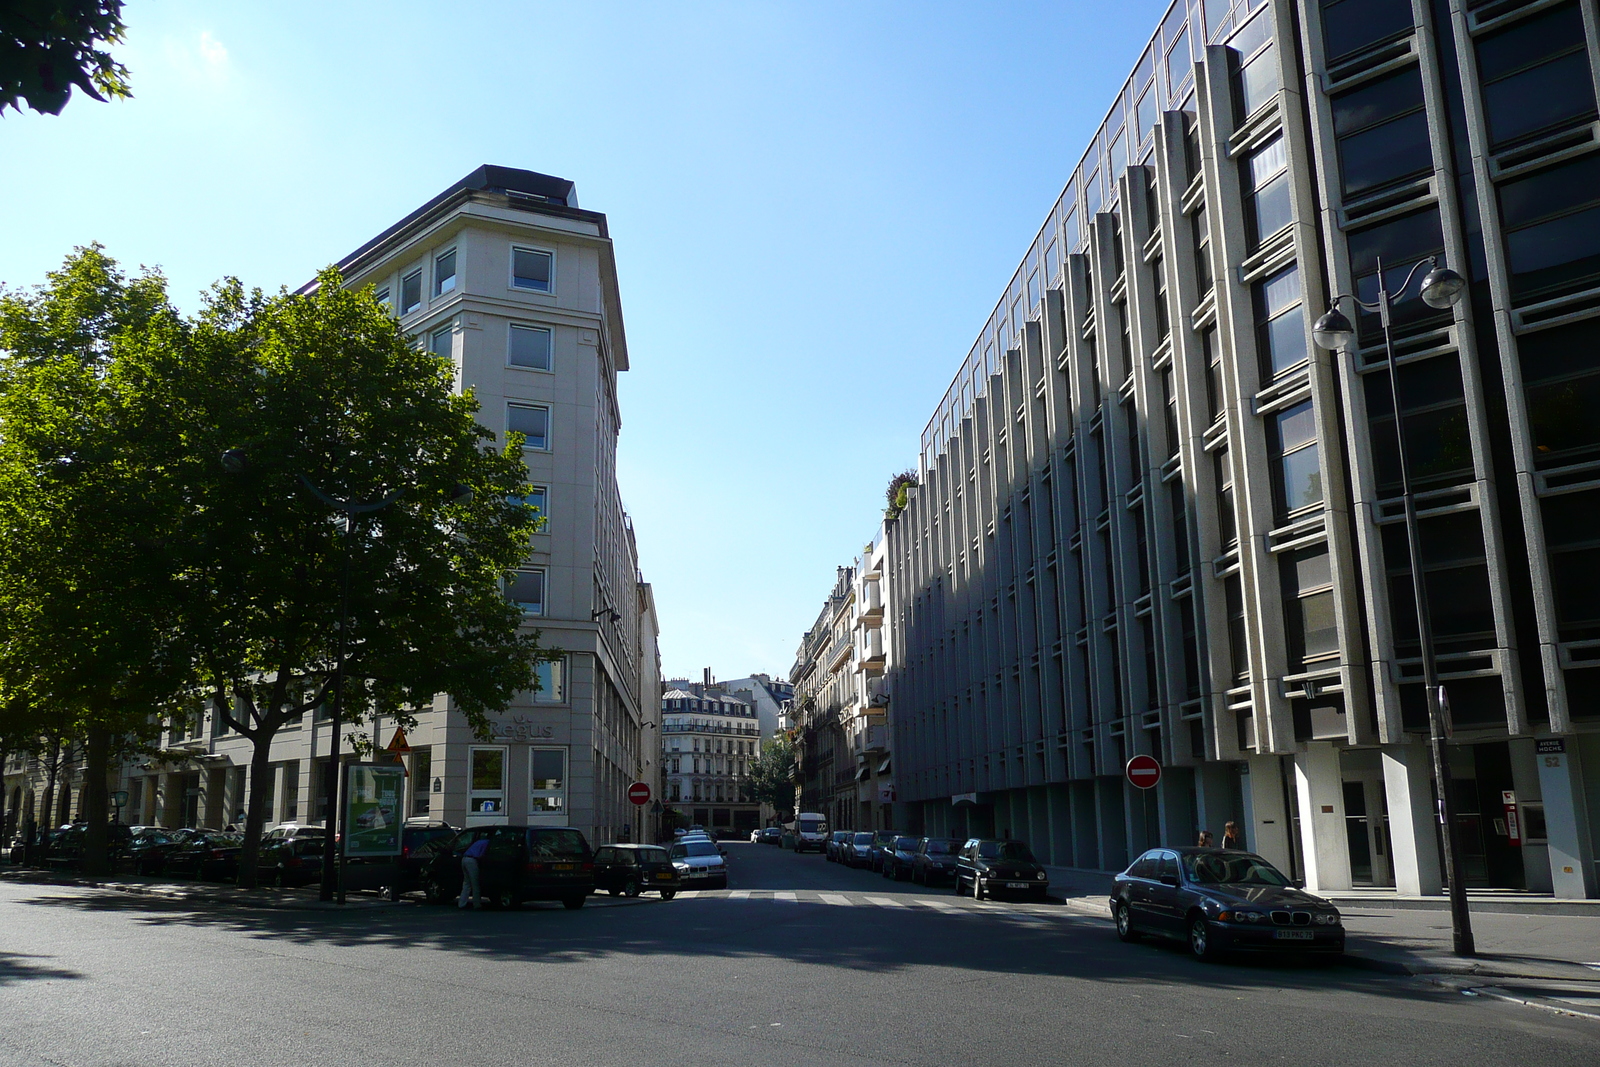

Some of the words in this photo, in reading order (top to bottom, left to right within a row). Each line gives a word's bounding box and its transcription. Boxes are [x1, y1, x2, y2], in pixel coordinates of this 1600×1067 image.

[489, 721, 554, 742] Regus
[1545, 757, 1560, 767] 52
[1305, 931, 1313, 939] 75
